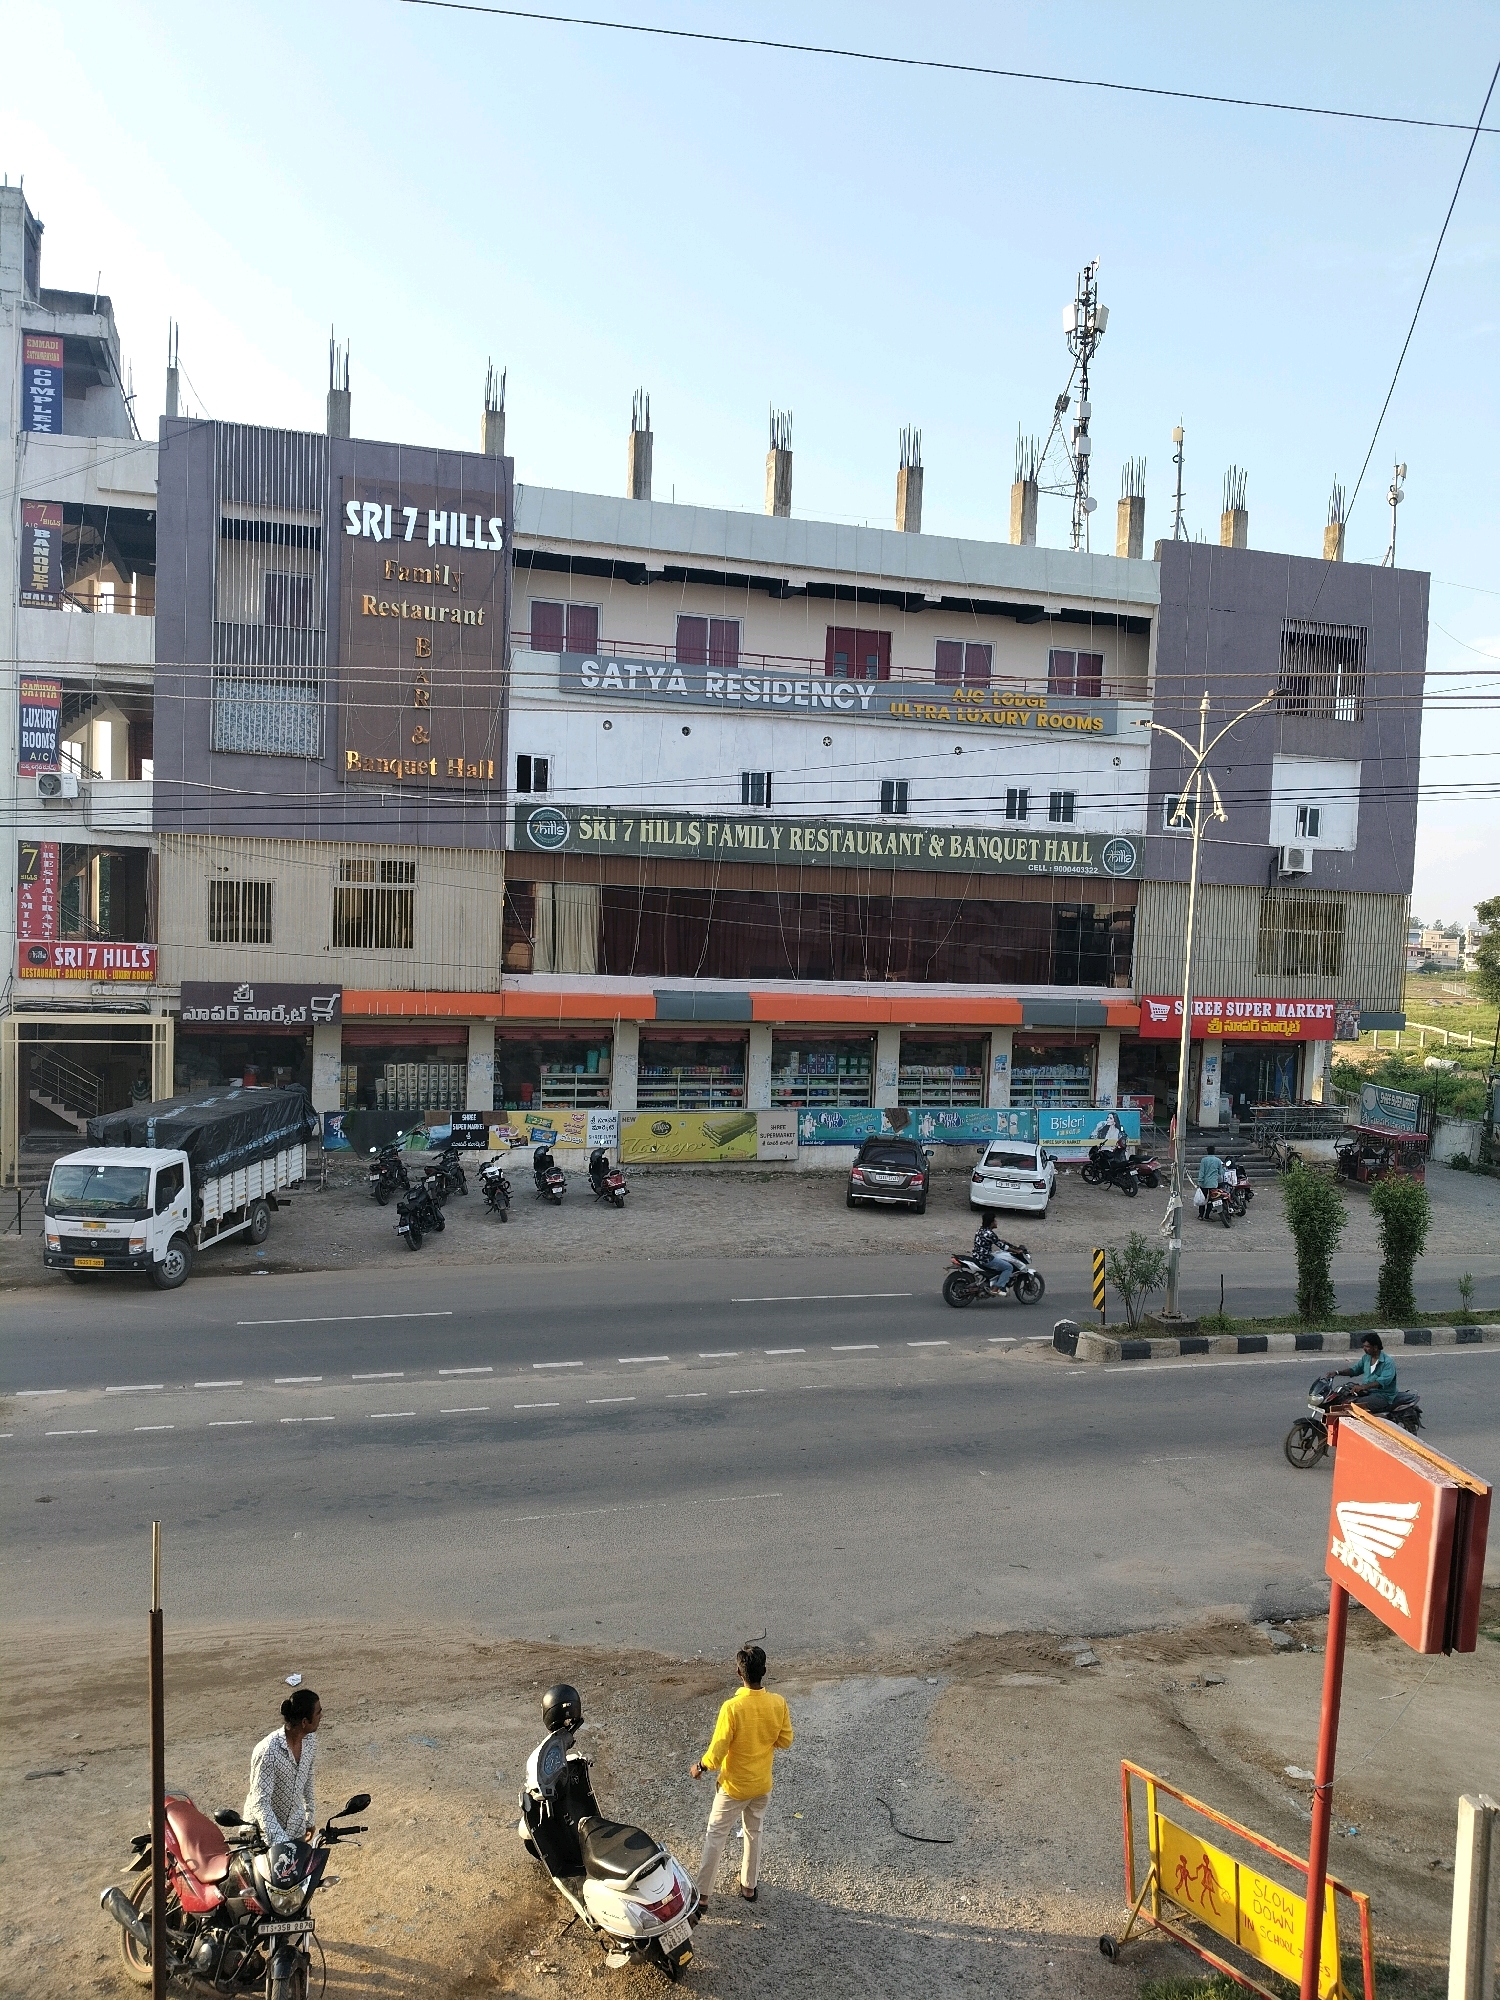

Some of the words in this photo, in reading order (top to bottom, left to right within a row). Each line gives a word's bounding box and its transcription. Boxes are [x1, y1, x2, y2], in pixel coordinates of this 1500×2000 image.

[26, 338, 59, 350] EMMADI
[29, 368, 56, 432] COMPLEX
[36, 504, 48, 522] 7
[42, 518, 61, 527] HILLS
[345, 500, 392, 543] SRI
[402, 506, 419, 542] 7
[427, 508, 504, 551] HILLS
[30, 528, 51, 591] BANQUET
[383, 558, 465, 592] Family
[22, 592, 57, 608] HALL
[361, 594, 486, 627] Restaurant
[414, 636, 432, 710] BAR
[580, 660, 688, 697] SATYA
[704, 671, 876, 710] RESIDENCY
[21, 682, 58, 699] SATHYA
[952, 688, 985, 704] A/C
[992, 691, 1048, 709] LODGE
[22, 707, 58, 730] LUXURY
[889, 702, 951, 721] ULTRA
[956, 706, 1031, 727] LUXURY
[1036, 713, 1104, 731] ROOMS
[22, 731, 56, 750] ROOMS
[411, 725, 431, 745] &
[345, 750, 438, 780] Banquet
[446, 757, 495, 781] Hall
[578, 814, 617, 841] SRI
[620, 818, 635, 842] 7
[640, 819, 702, 846] HILLS
[705, 822, 784, 850] FAMILY
[788, 827, 924, 856] RESTAURANT
[928, 833, 945, 858] &
[949, 835, 1041, 864] BANQUET
[1044, 840, 1093, 864] HALL
[21, 848, 39, 874] 7
[1027, 864, 1049, 873] CELL
[41, 852, 55, 938] RESTAURANT
[20, 882, 33, 938] FAMILY
[54, 947, 83, 969] SRI
[88, 948, 98, 967] 7
[103, 948, 151, 969] HILLS
[21, 967, 61, 979] RESTAURANT
[64, 968, 93, 980] BANQUET
[93, 969, 108, 980] HALL
[112, 969, 132, 980] LUXURY
[132, 971, 154, 981] ROOMS
[182, 1005, 240, 1021] సూపర్
[1174, 1000, 1223, 1016] SREE
[1225, 1001, 1272, 1017] SUPER
[1274, 1003, 1334, 1019] MARKET
[1207, 1017, 1223, 1034] శ్రీ
[1224, 1019, 1259, 1033] సూపర్
[1050, 1114, 1086, 1130] Bisleri
[1330, 1535, 1412, 1619] HONDA
[1253, 1878, 1294, 1918] SLOW
[1253, 1898, 1295, 1935] DOWN
[1244, 1914, 1255, 1932] IN
[1259, 1925, 1296, 1957] SCHOOL
